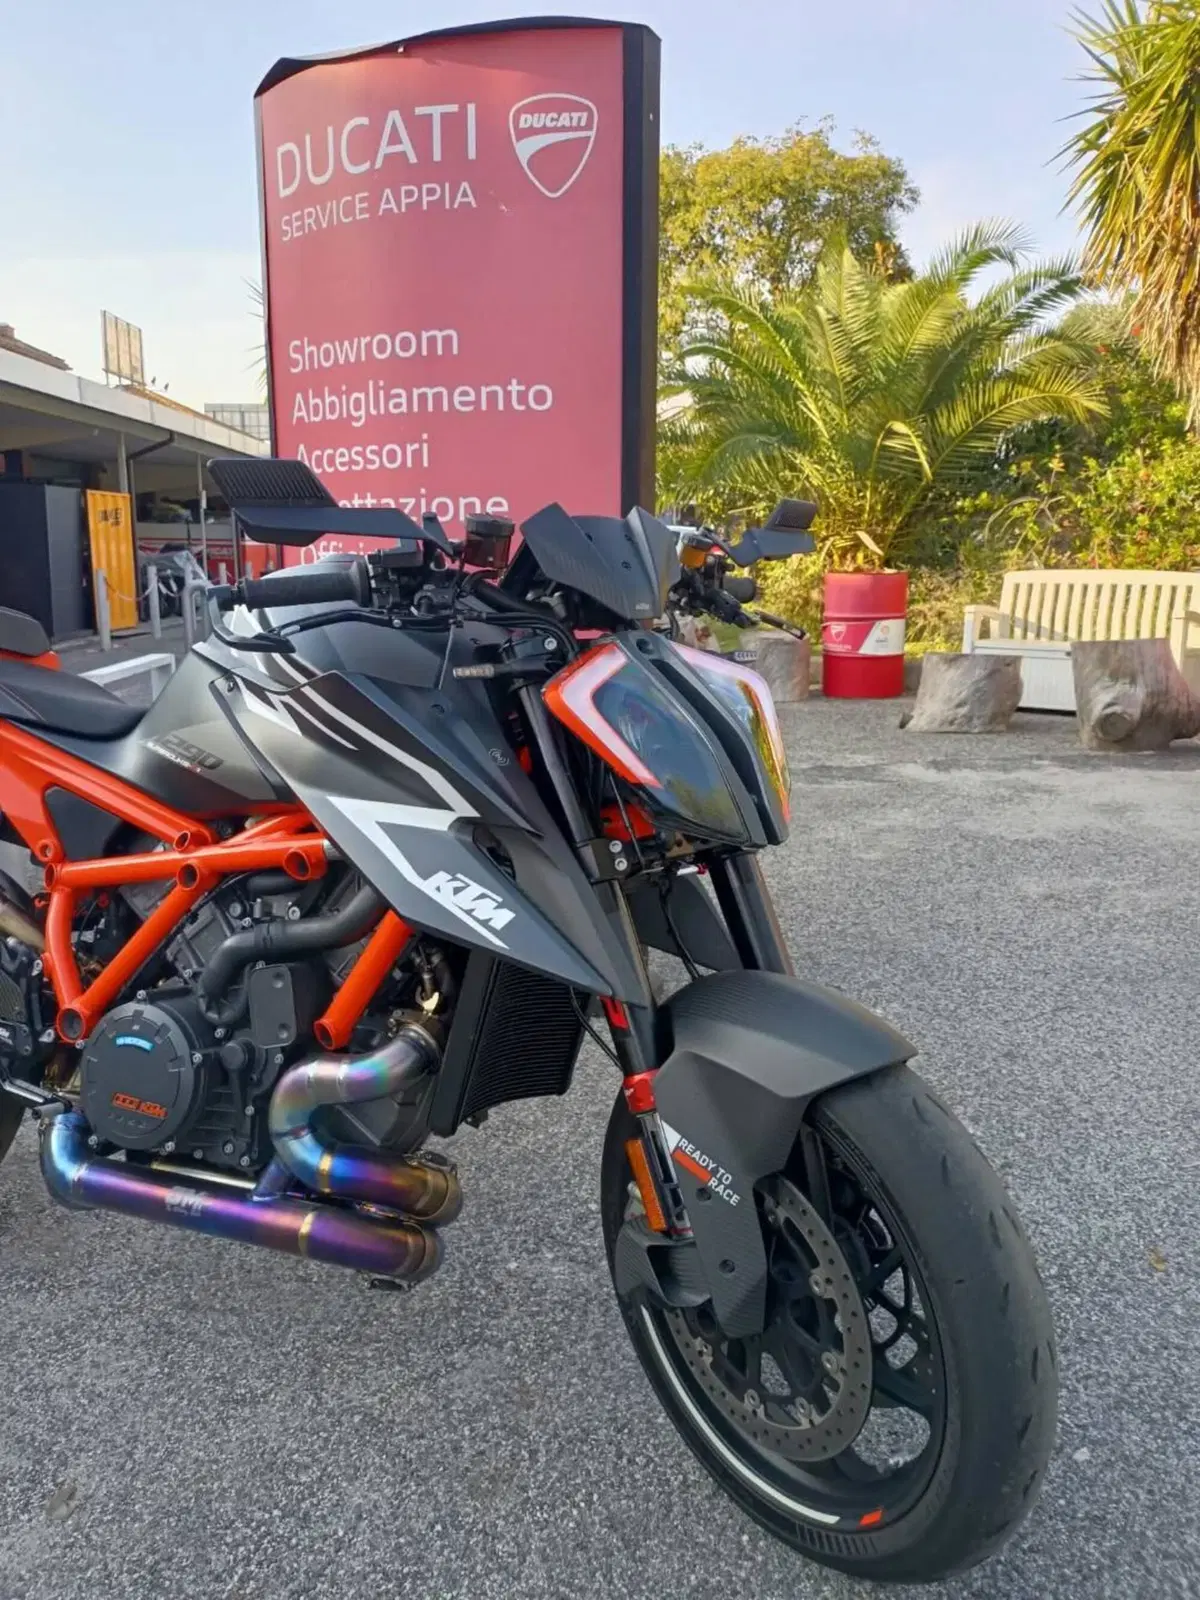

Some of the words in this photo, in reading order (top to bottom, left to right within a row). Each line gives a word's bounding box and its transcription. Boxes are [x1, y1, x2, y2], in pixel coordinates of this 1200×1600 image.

[518, 111, 589, 129] DUCATI
[276, 102, 477, 198] DUCATI
[280, 192, 370, 241] SERVICE
[378, 180, 477, 216] APPIA
[289, 327, 459, 373] Showroom
[292, 378, 553, 427] Abbigliamento
[297, 433, 430, 474] Accessori
[420, 870, 516, 931] KTM
[678, 1138, 717, 1172] READY
[714, 1166, 732, 1186] TO
[707, 1177, 741, 1207] RACE
